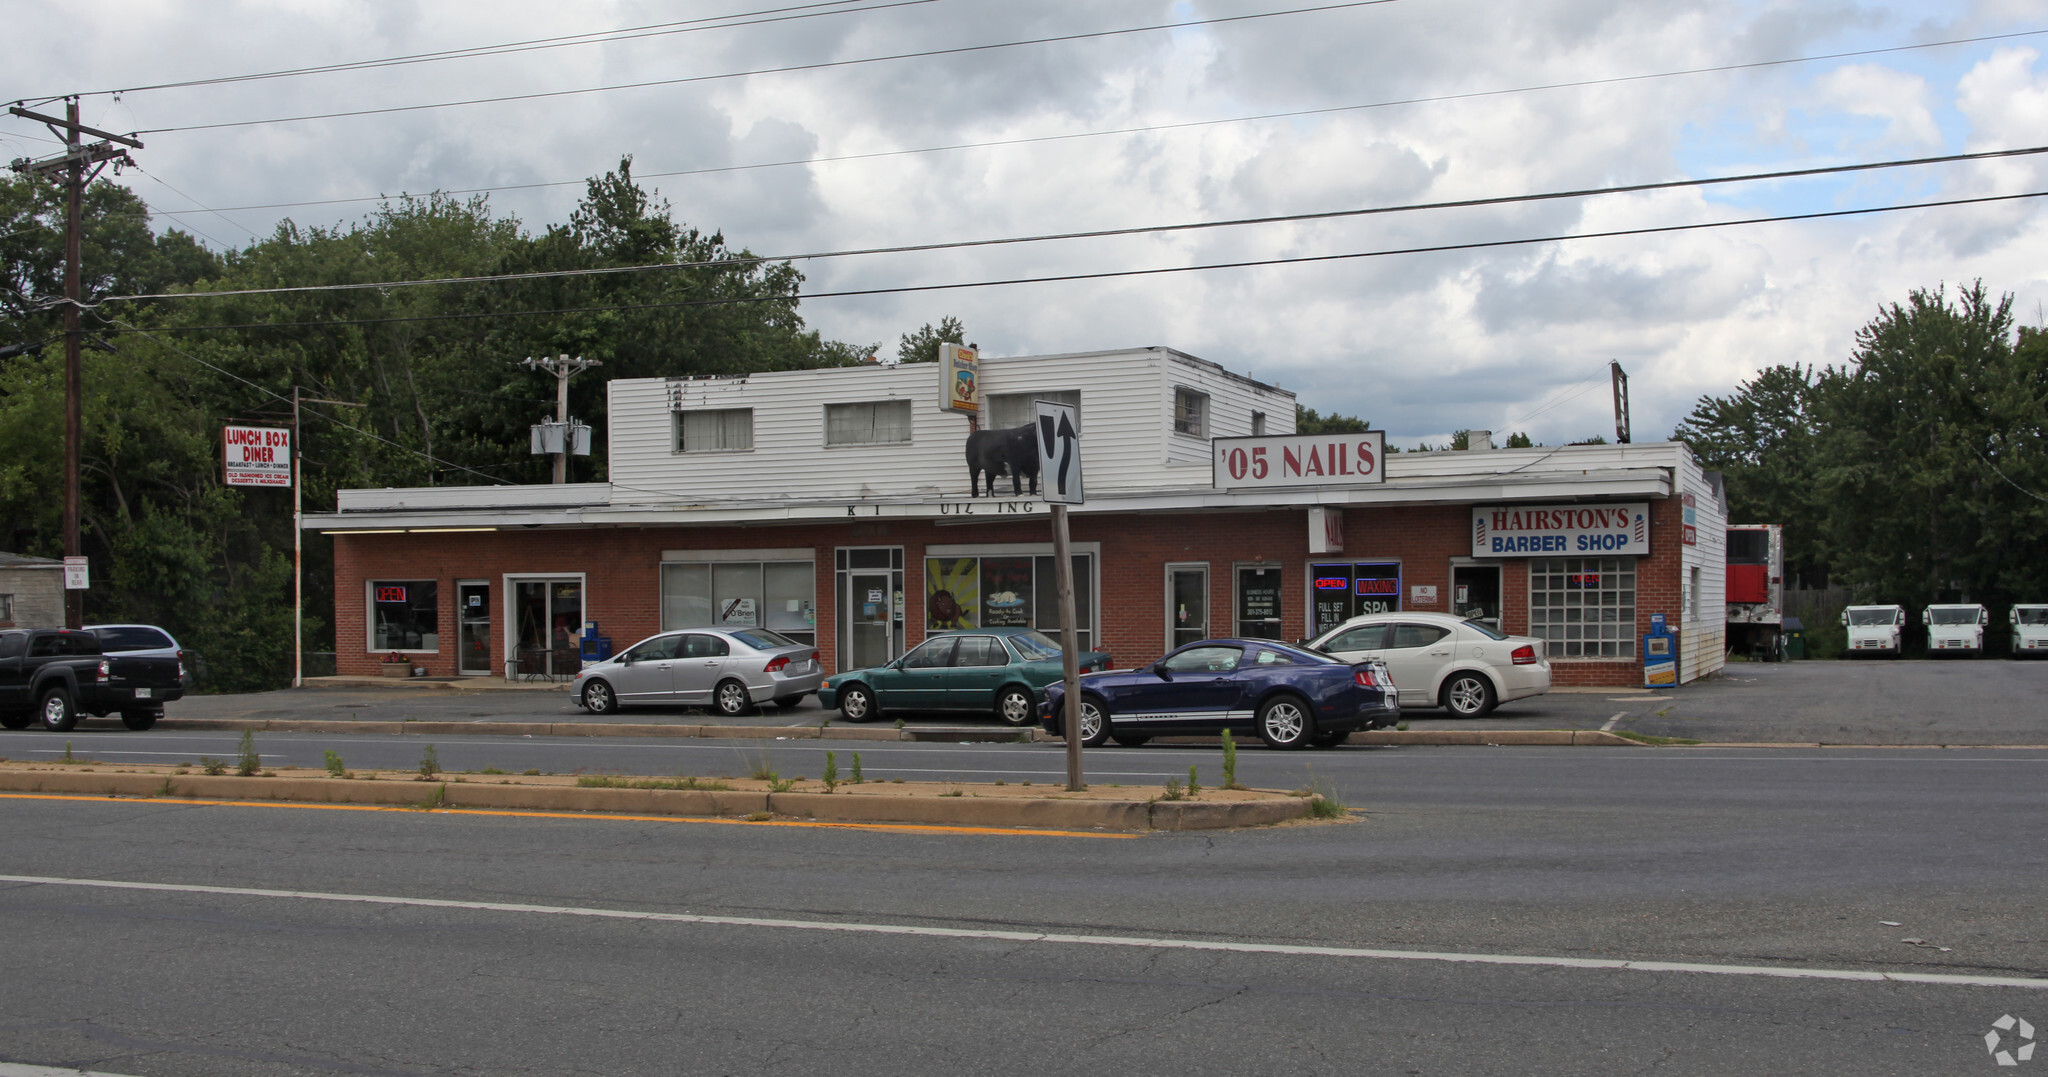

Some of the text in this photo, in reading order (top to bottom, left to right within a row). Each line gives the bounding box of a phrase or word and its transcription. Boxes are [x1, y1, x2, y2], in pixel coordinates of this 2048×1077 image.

[227, 429, 288, 447] LUNCH BOX
[243, 446, 274, 463] DINER
[1221, 442, 1375, 480] '05 NAILS
[847, 505, 856, 516] K
[875, 504, 880, 515] I
[997, 502, 1033, 513] ING
[1491, 507, 1629, 531] HAIRSTON'S
[1325, 515, 1343, 547] NAILS
[1491, 534, 1628, 552] BARBER SHOP
[1315, 579, 1345, 588] OPEN
[1572, 574, 1599, 583] OPEN
[1358, 580, 1397, 593] WAXING
[376, 587, 405, 601] OPEN
[1412, 595, 1436, 603] LOITERING
[731, 609, 755, 617] O'Brien
[1318, 602, 1343, 612] FULL SET
[1363, 601, 1388, 615] SPA
[1321, 612, 1340, 622] FILL IN
